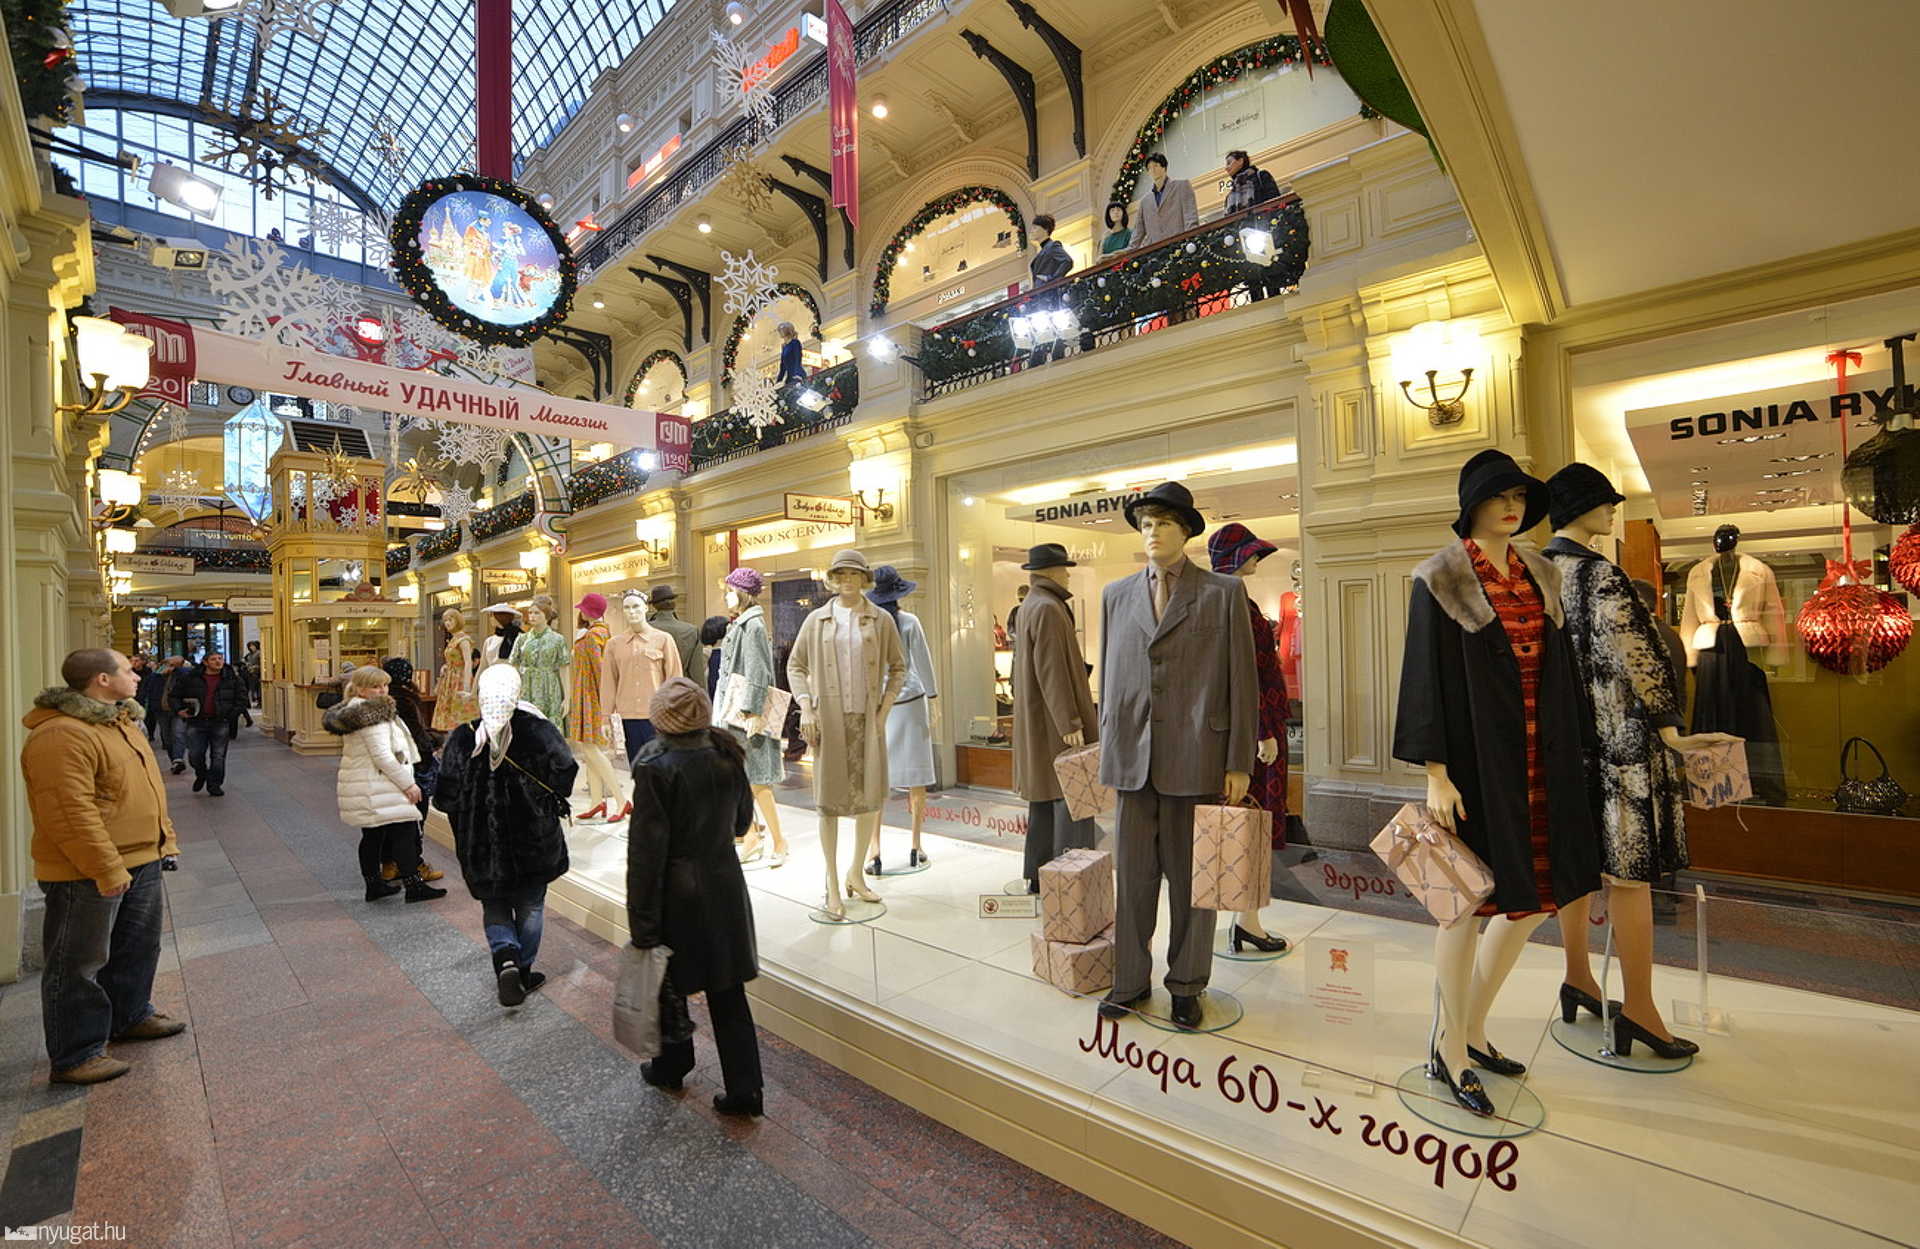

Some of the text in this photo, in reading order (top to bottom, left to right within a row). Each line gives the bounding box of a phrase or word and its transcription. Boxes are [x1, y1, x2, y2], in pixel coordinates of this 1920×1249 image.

[146, 375, 179, 394] 20
[283, 360, 609, 431] Главный УДАЧНЫЙ Магазин
[1670, 400, 1819, 440] SONIA
[665, 453, 685, 465] 120
[1035, 500, 1093, 523] SONIA
[223, 533, 256, 542] VUITTO
[777, 522, 851, 541] SCERVI
[1079, 1013, 1519, 1191] Мода 60-х годов
